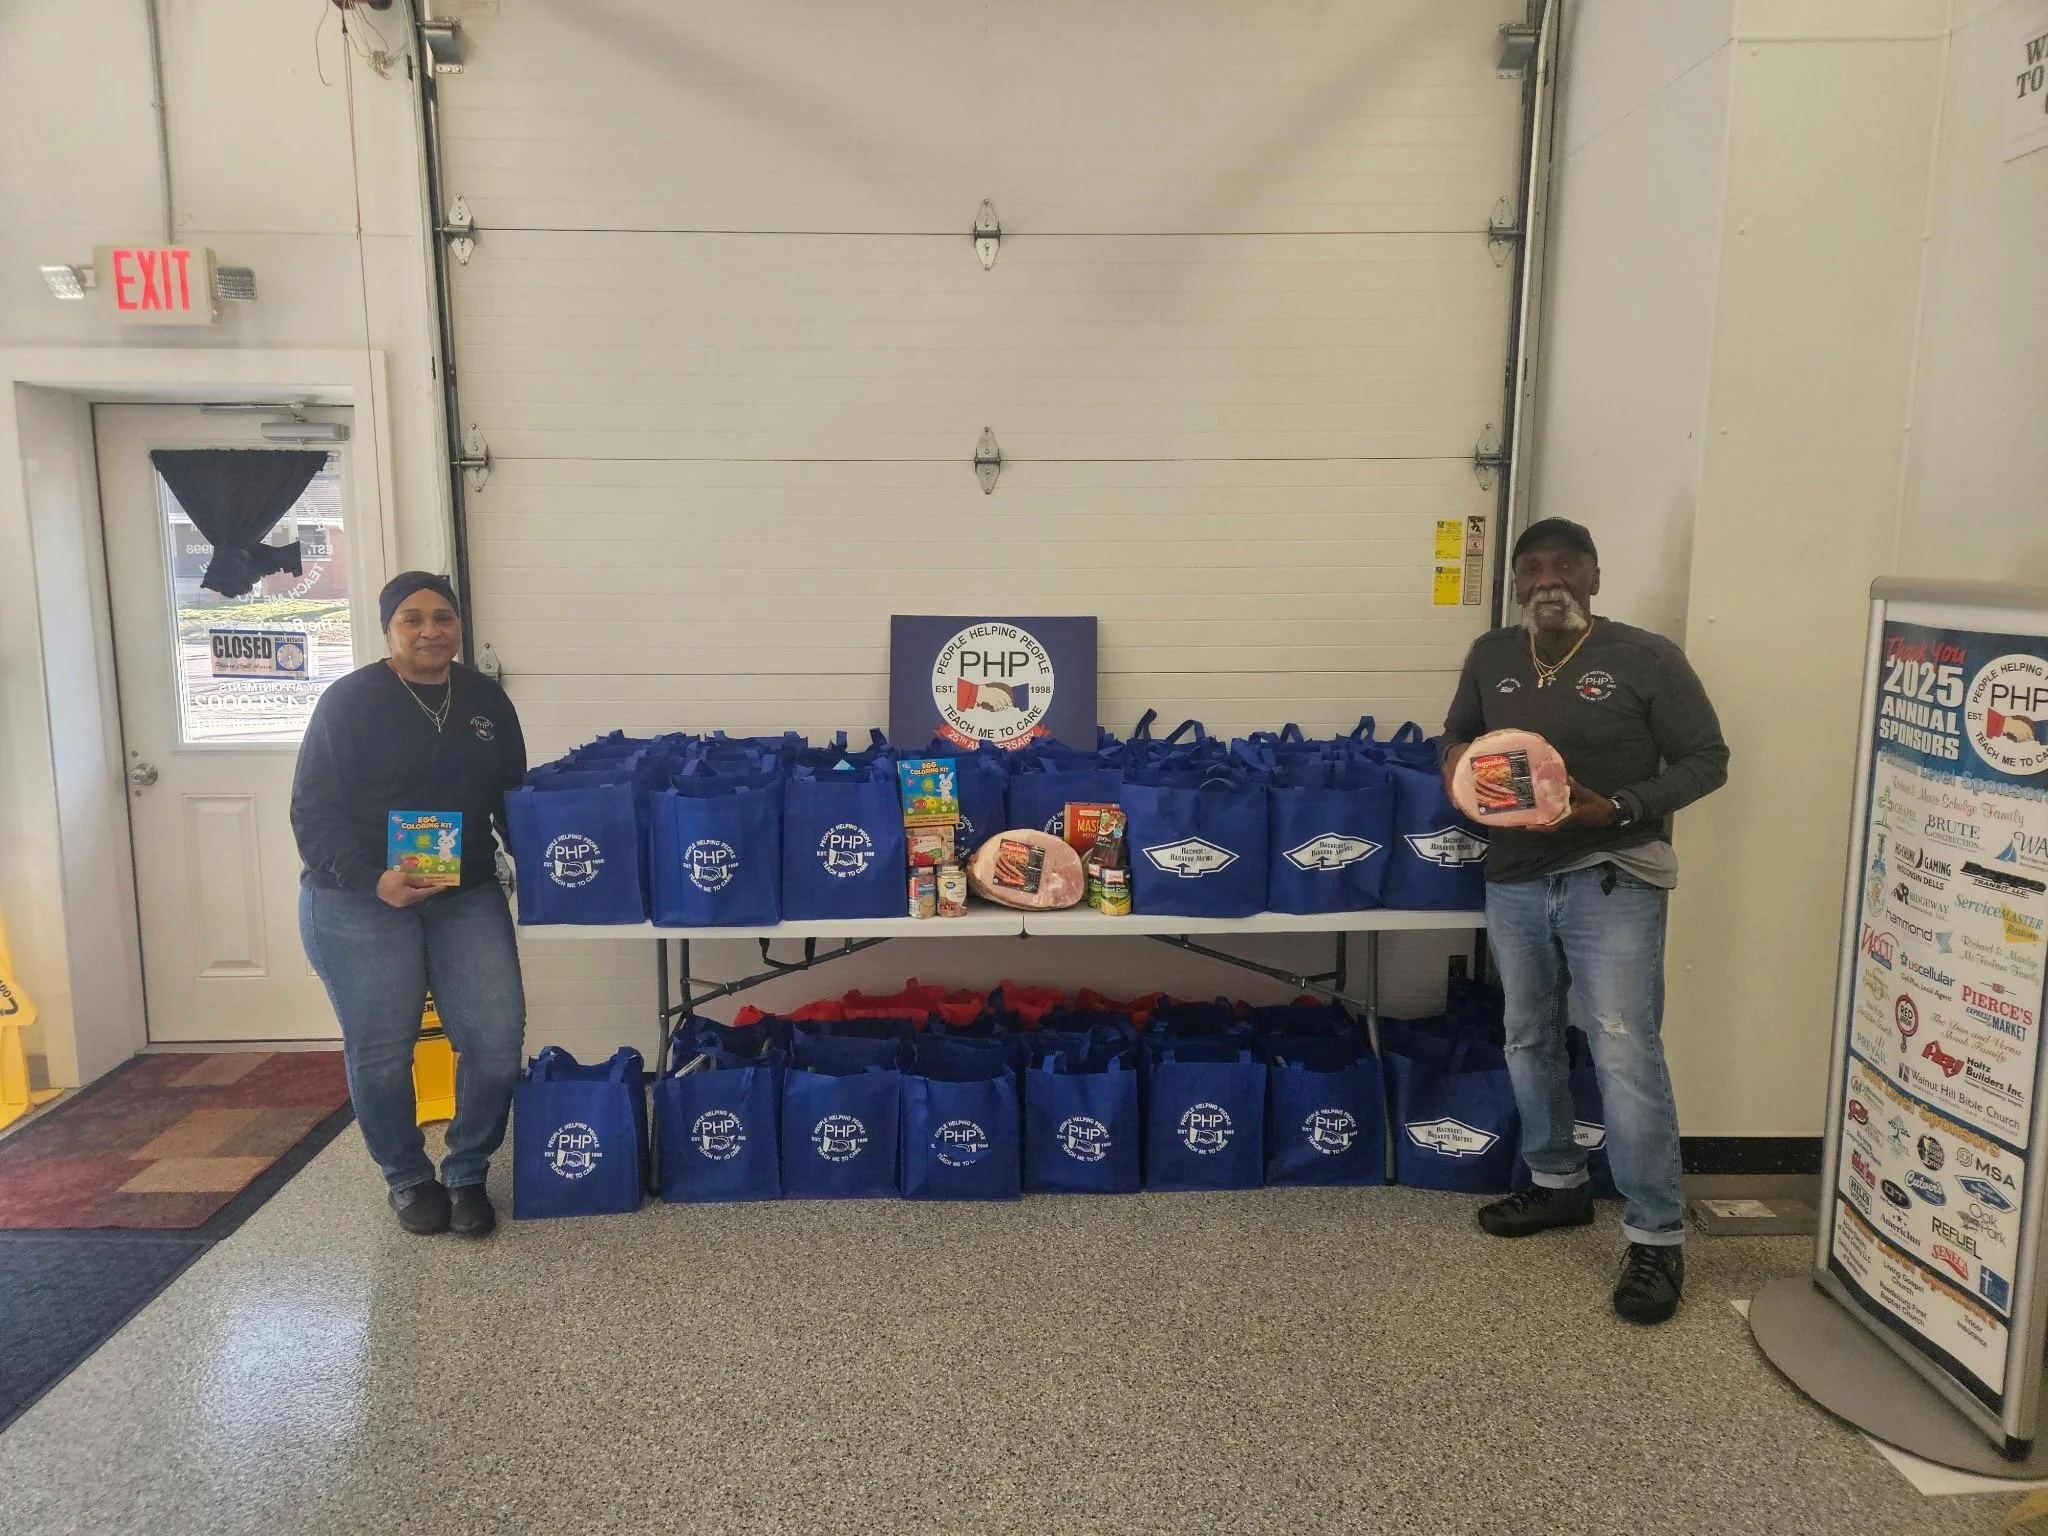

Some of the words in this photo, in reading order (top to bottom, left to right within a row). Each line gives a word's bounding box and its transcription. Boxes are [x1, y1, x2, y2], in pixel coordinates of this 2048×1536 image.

[2017, 65, 2045, 99] TO
[113, 249, 191, 311] EXIT
[212, 635, 273, 660] CLOSED
[937, 635, 968, 675] PEOPLE
[969, 625, 1018, 640] HELPING
[1019, 635, 1050, 675] PEOPLE
[960, 651, 1030, 677] PHP
[935, 685, 955, 694] EST.
[1030, 686, 1051, 694] 1998
[1884, 655, 1964, 708] 2025
[1973, 669, 1999, 704] PEOPLE
[2000, 662, 2043, 676] HELPING
[943, 704, 975, 734] TEACH
[978, 727, 994, 739] ME
[999, 726, 1014, 738] TO
[1016, 704, 1043, 732] CARE
[1881, 695, 1960, 736] ANNUAL
[1967, 711, 1984, 721] EST.
[1879, 717, 1960, 761] SPONSORS
[1975, 730, 1999, 760] TEACH
[2001, 755, 2016, 767] ME
[2020, 754, 2033, 767] TO
[910, 767, 939, 775] COLORING
[922, 761, 937, 769] EGG
[1920, 761, 1955, 787] Level
[401, 822, 440, 831] COLORING
[417, 815, 437, 824] EGG
[1928, 814, 1980, 840] BRUTE
[1981, 802, 2024, 828] Family
[546, 838, 559, 858] PEOPLE
[556, 834, 582, 842] HELPING
[583, 836, 601, 856] PEOPLE
[819, 827, 836, 848] PEOPLE
[835, 823, 858, 831] HELPING
[858, 828, 873, 848] PEOPLE
[830, 834, 864, 850] PHP
[555, 844, 590, 860] PHP
[693, 849, 727, 865] PHP
[1896, 862, 1923, 883] WISCONSIN
[1923, 876, 1945, 891] DELLS
[1924, 856, 1952, 877] GAMING
[1974, 878, 2010, 892] TRANSIT
[1909, 890, 1950, 914] RIDGEWAY
[1955, 893, 2044, 930] ServiceMASTER
[1886, 906, 1933, 942] hammond
[1921, 983, 1933, 995] Local
[1900, 1004, 1914, 1020] RED
[1961, 984, 2033, 1026] PIERCE'S
[1966, 1006, 1993, 1021] EXPRESS
[1992, 1015, 2027, 1042] MARKET
[1857, 1032, 1887, 1065] PREVAIL
[1966, 1057, 1991, 1074] Holtz
[1965, 1066, 2005, 1090] Builders
[2007, 1083, 2025, 1100] Inc.
[1911, 1069, 1939, 1092] Walnut
[1941, 1084, 1956, 1100] Hill
[1959, 1092, 1983, 1113] Bible
[1986, 1105, 2021, 1130] Church
[702, 1119, 735, 1135] PHP
[824, 1123, 857, 1138] PHP
[1068, 1124, 1101, 1140] PHP
[1191, 1113, 1224, 1128] PHP
[1315, 1116, 1349, 1131] PHP
[547, 1127, 565, 1148] PEOPLE
[563, 1122, 588, 1130] HELPING
[587, 1127, 600, 1149] PEOPLE
[559, 1134, 592, 1149] PHP
[944, 1129, 977, 1143] PHP
[1907, 1170, 1944, 1195] Culver's
[1975, 1157, 2017, 1191] MSA
[1969, 1203, 1998, 1229] Oak
[1931, 1215, 1983, 1261] REFUEL
[1980, 1220, 2007, 1247] Park
[1883, 1260, 1901, 1280] Living
[1931, 1244, 1969, 1276] SENECA
[1891, 1276, 1914, 1297] Church
[1902, 1306, 1925, 1328] Church
